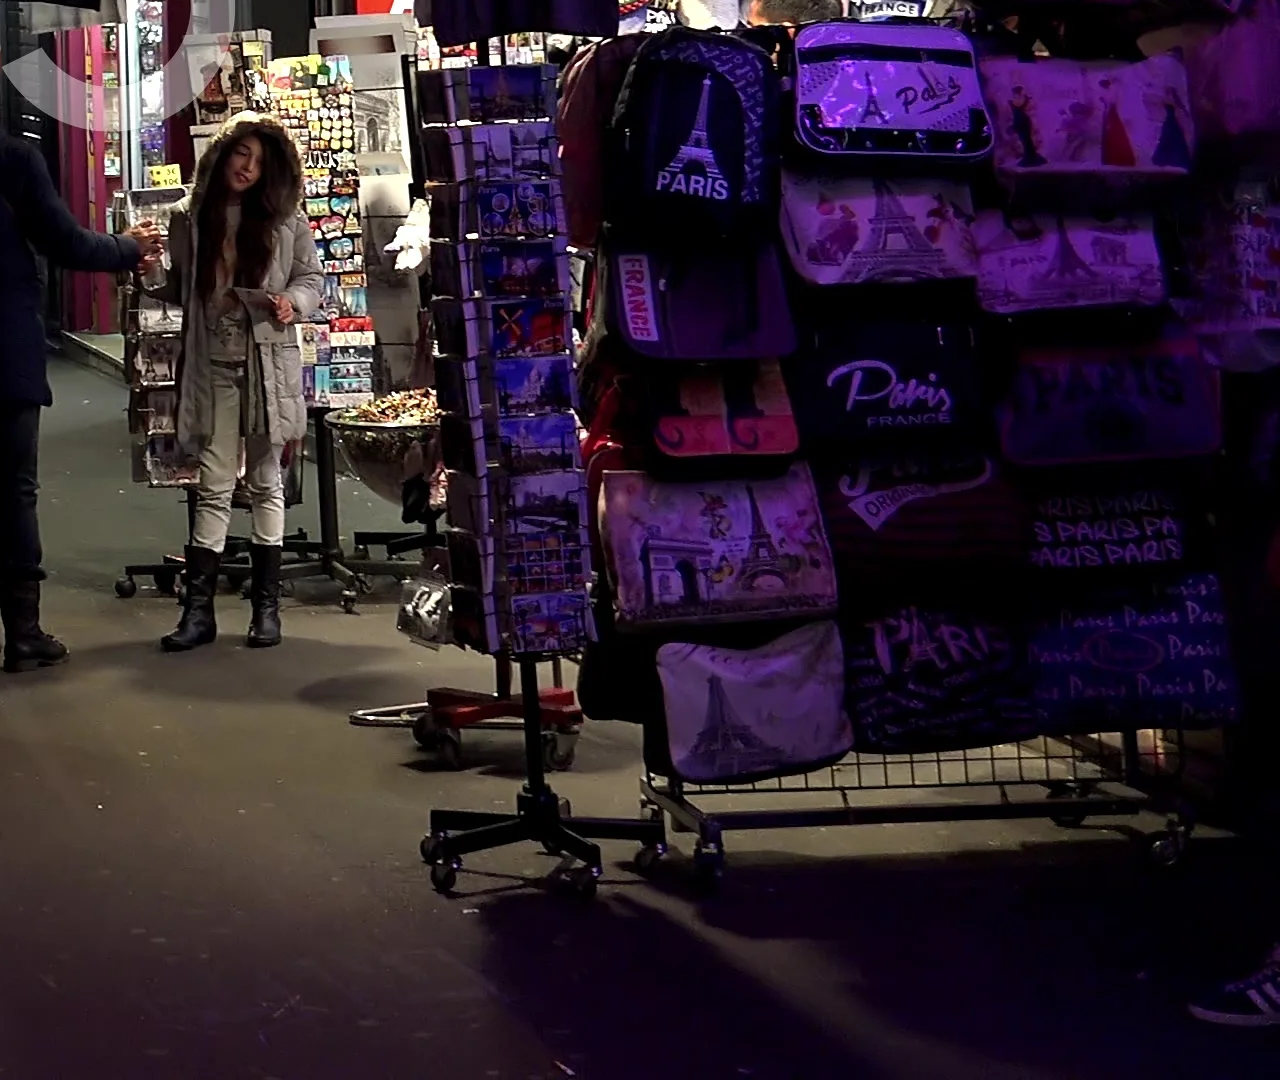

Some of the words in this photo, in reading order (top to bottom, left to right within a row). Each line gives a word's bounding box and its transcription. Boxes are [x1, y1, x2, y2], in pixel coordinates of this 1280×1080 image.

[655, 170, 729, 201] PARIS
[623, 256, 652, 340] FRANCE
[826, 359, 953, 413] Paris
[865, 412, 953, 428] FRANCE
[1055, 517, 1141, 543] PARIS
[1103, 537, 1184, 567] PARIS
